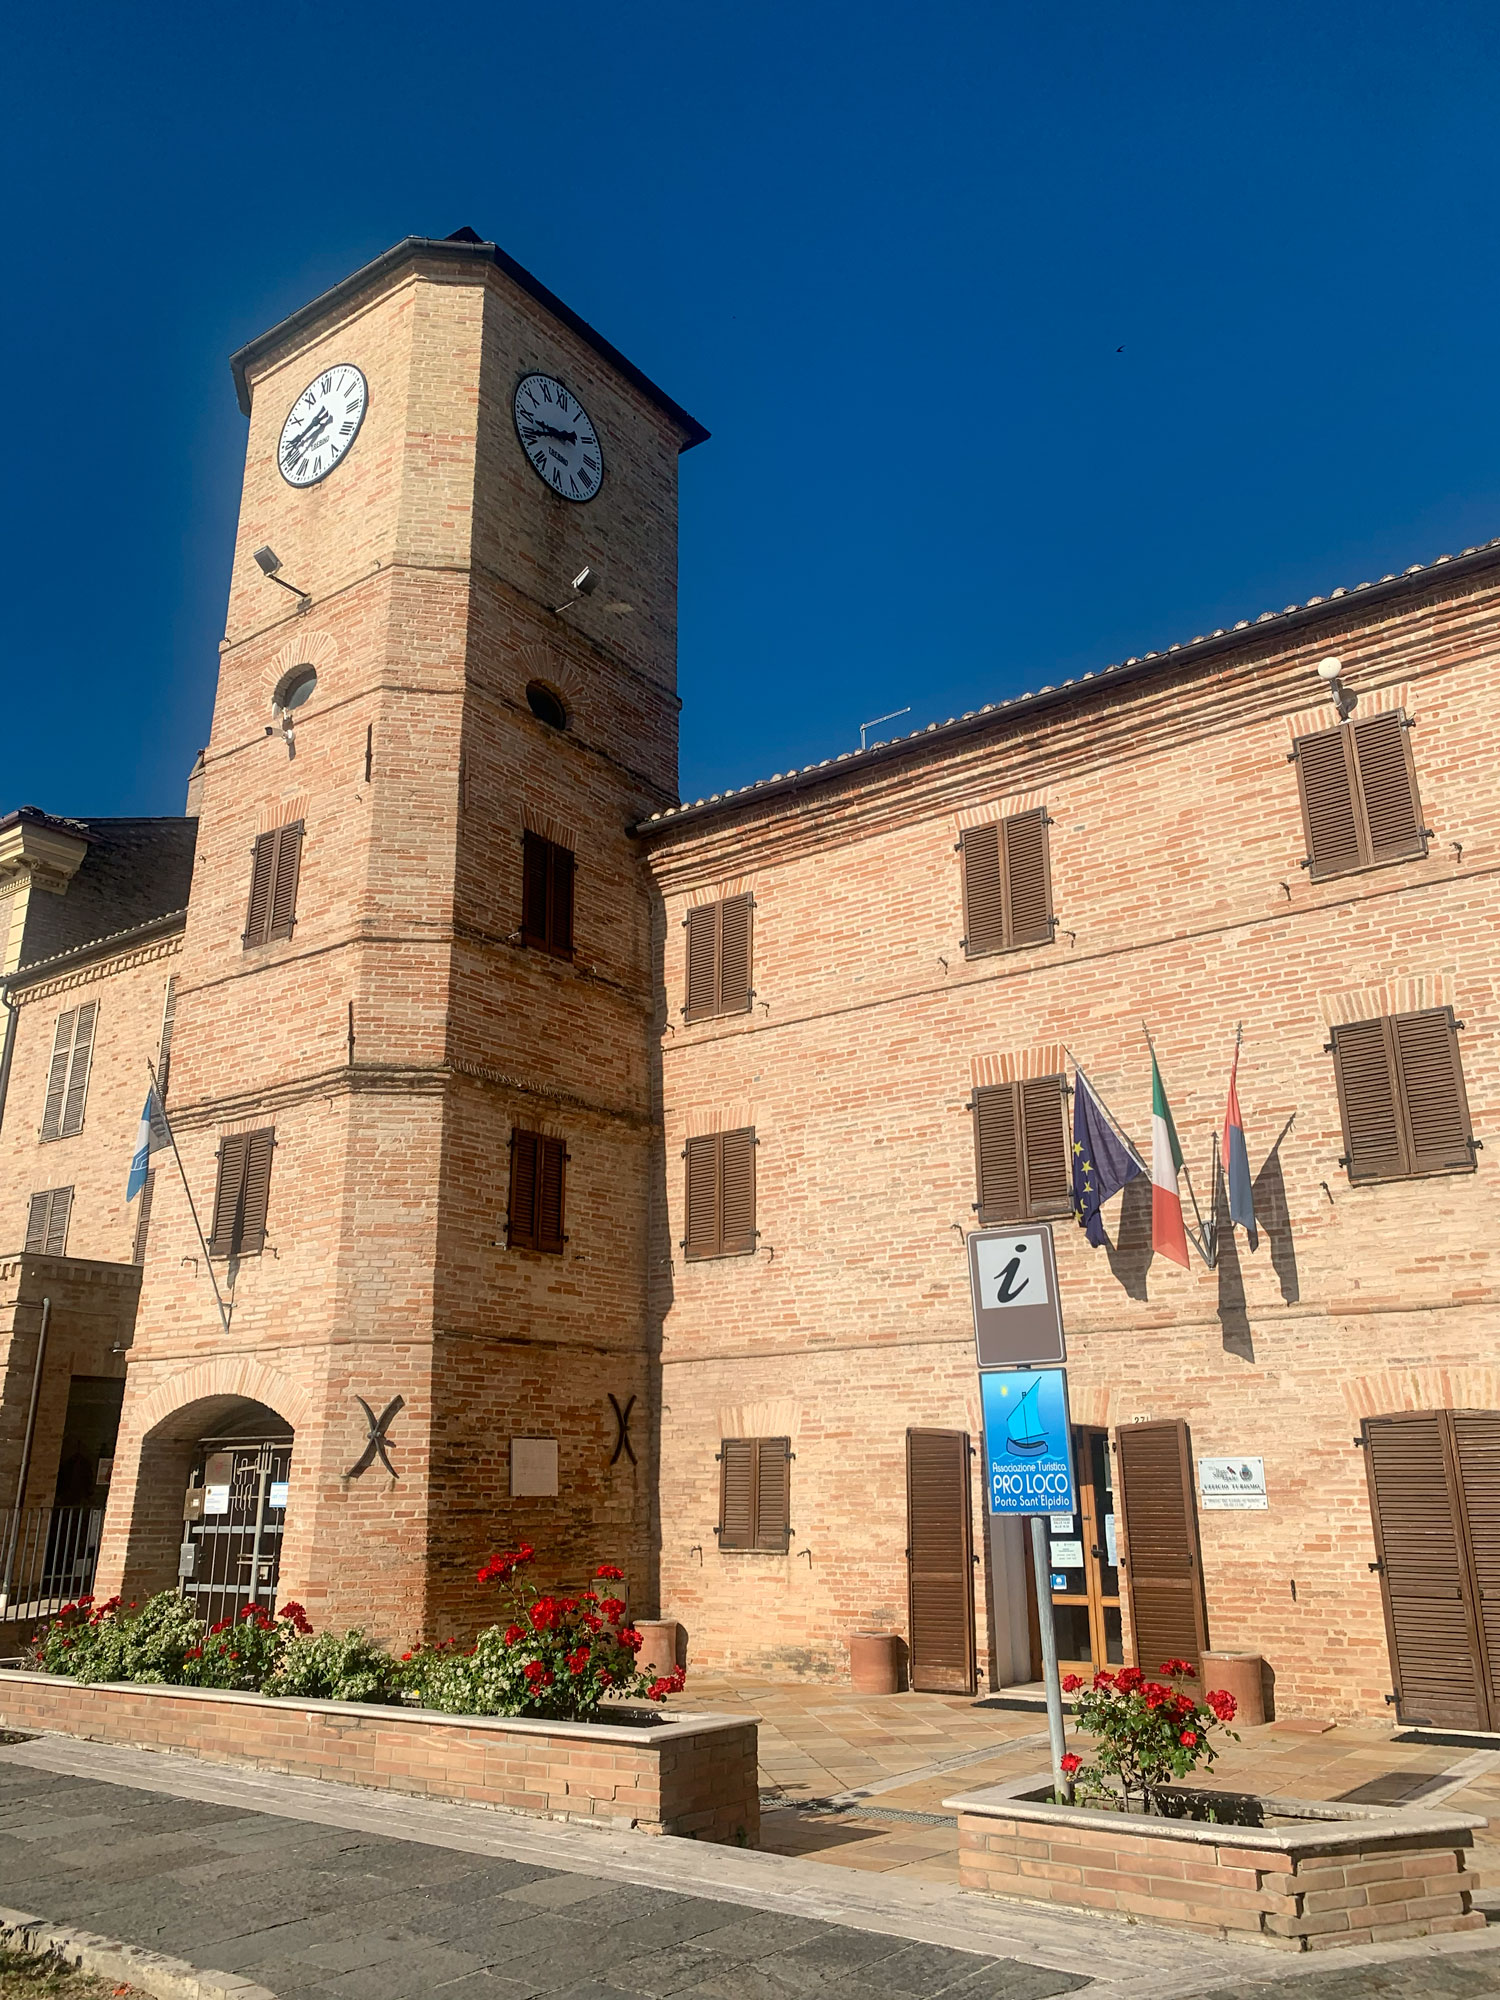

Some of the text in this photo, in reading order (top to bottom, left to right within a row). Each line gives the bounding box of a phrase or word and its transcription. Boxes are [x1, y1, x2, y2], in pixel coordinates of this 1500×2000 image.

[320, 376, 332, 398] XII
[344, 381, 357, 398] II
[304, 392, 317, 410] XI
[346, 398, 360, 414] III
[525, 387, 540, 408] X
[556, 388, 568, 412] XII
[290, 416, 304, 426] X
[580, 436, 594, 444] II
[331, 443, 339, 458] V
[313, 455, 321, 473] VI
[533, 450, 547, 471] VII
[583, 453, 597, 471] III
[552, 467, 562, 488] VI
[569, 474, 580, 493] V
[992, 1460, 1067, 1473] Associazione Turistica
[993, 1473, 1069, 1495] PRO LOCO
[994, 1494, 1070, 1510] Porto Sant'Elpidio
